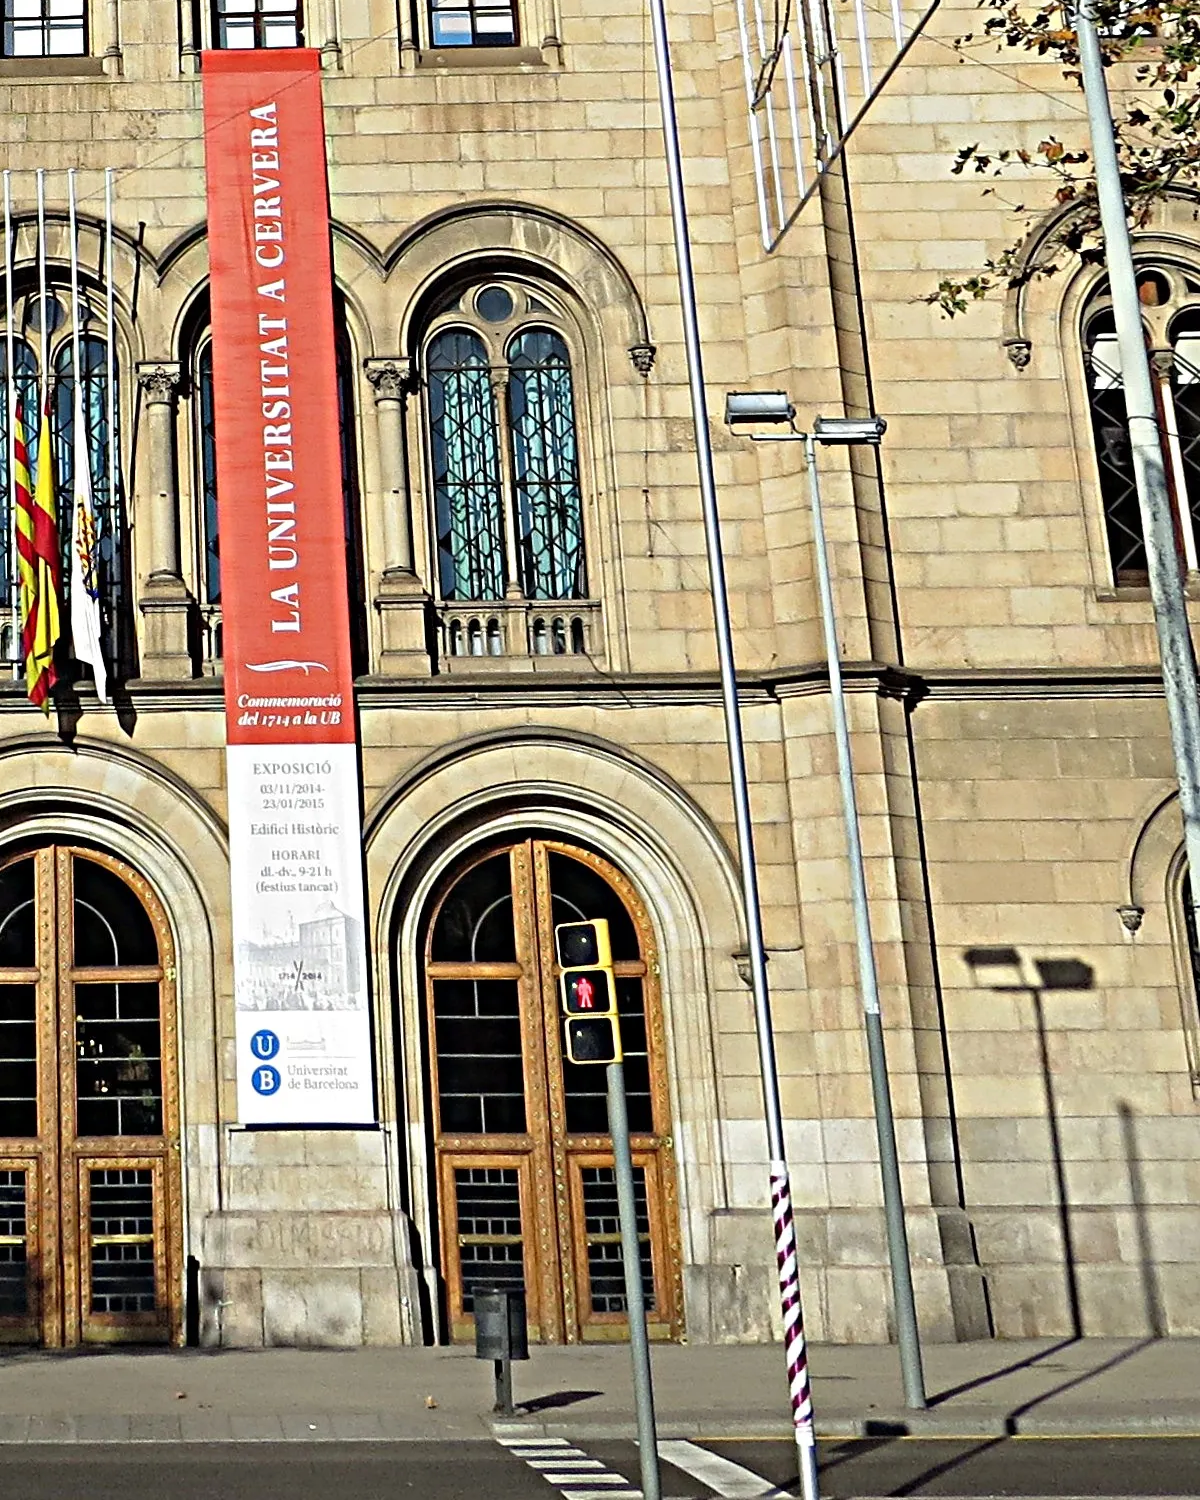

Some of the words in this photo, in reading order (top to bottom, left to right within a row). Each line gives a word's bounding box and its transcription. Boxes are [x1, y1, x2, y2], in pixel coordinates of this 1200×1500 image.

[250, 101, 285, 268] CERVERA
[257, 279, 285, 304] A
[258, 313, 299, 571] UNIVERSITAT
[271, 582, 302, 634] LA
[237, 693, 342, 708] Commemoració
[237, 711, 260, 726] del
[262, 714, 290, 727] 1714
[292, 715, 302, 725] a
[304, 711, 318, 725] la
[320, 711, 342, 725] UB
[253, 760, 332, 775] EXPOSICIÓ
[260, 783, 325, 795] 03/11/2014-
[262, 798, 325, 810] 23/01/2015
[250, 823, 289, 836] Edifici
[291, 823, 340, 835] Històric
[271, 850, 320, 861] HORARI
[324, 866, 332, 877] h
[255, 881, 297, 894] (festius
[298, 880, 339, 894] tancat)
[256, 1035, 274, 1057] U
[287, 1064, 349, 1076] Universitat
[258, 1070, 275, 1092] B
[287, 1078, 301, 1090] de
[303, 1078, 359, 1090] Barcelona
